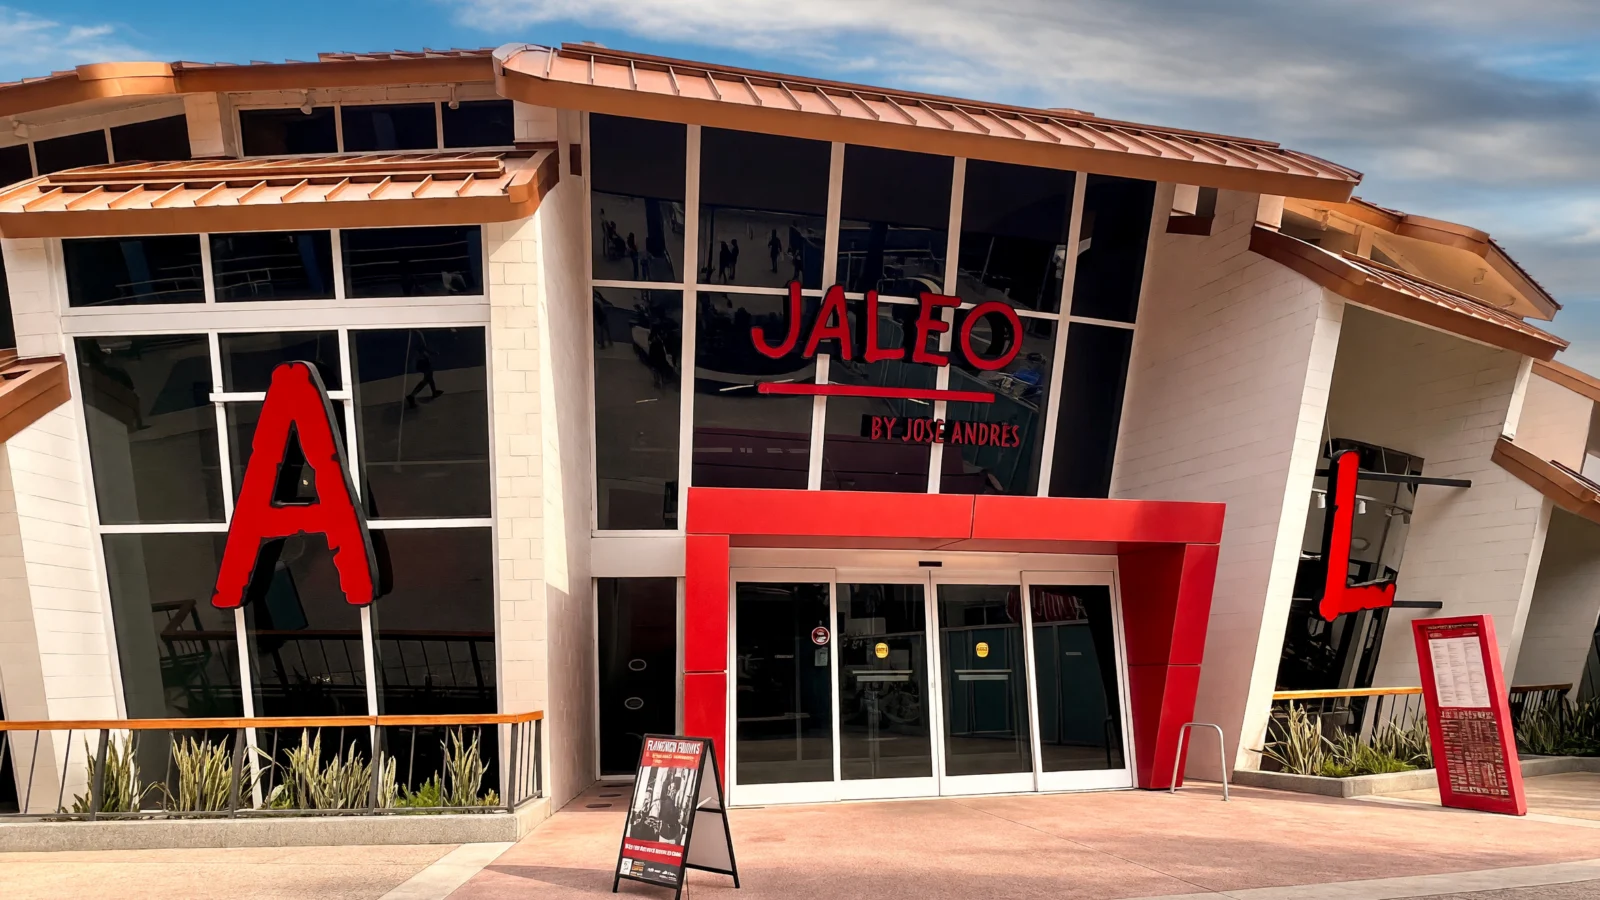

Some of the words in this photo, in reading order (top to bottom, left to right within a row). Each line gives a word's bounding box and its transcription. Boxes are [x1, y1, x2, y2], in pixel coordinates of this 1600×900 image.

[751, 280, 1023, 370] JALEO
[212, 361, 378, 608] A
[871, 415, 897, 440] BY
[1319, 450, 1396, 622] L
